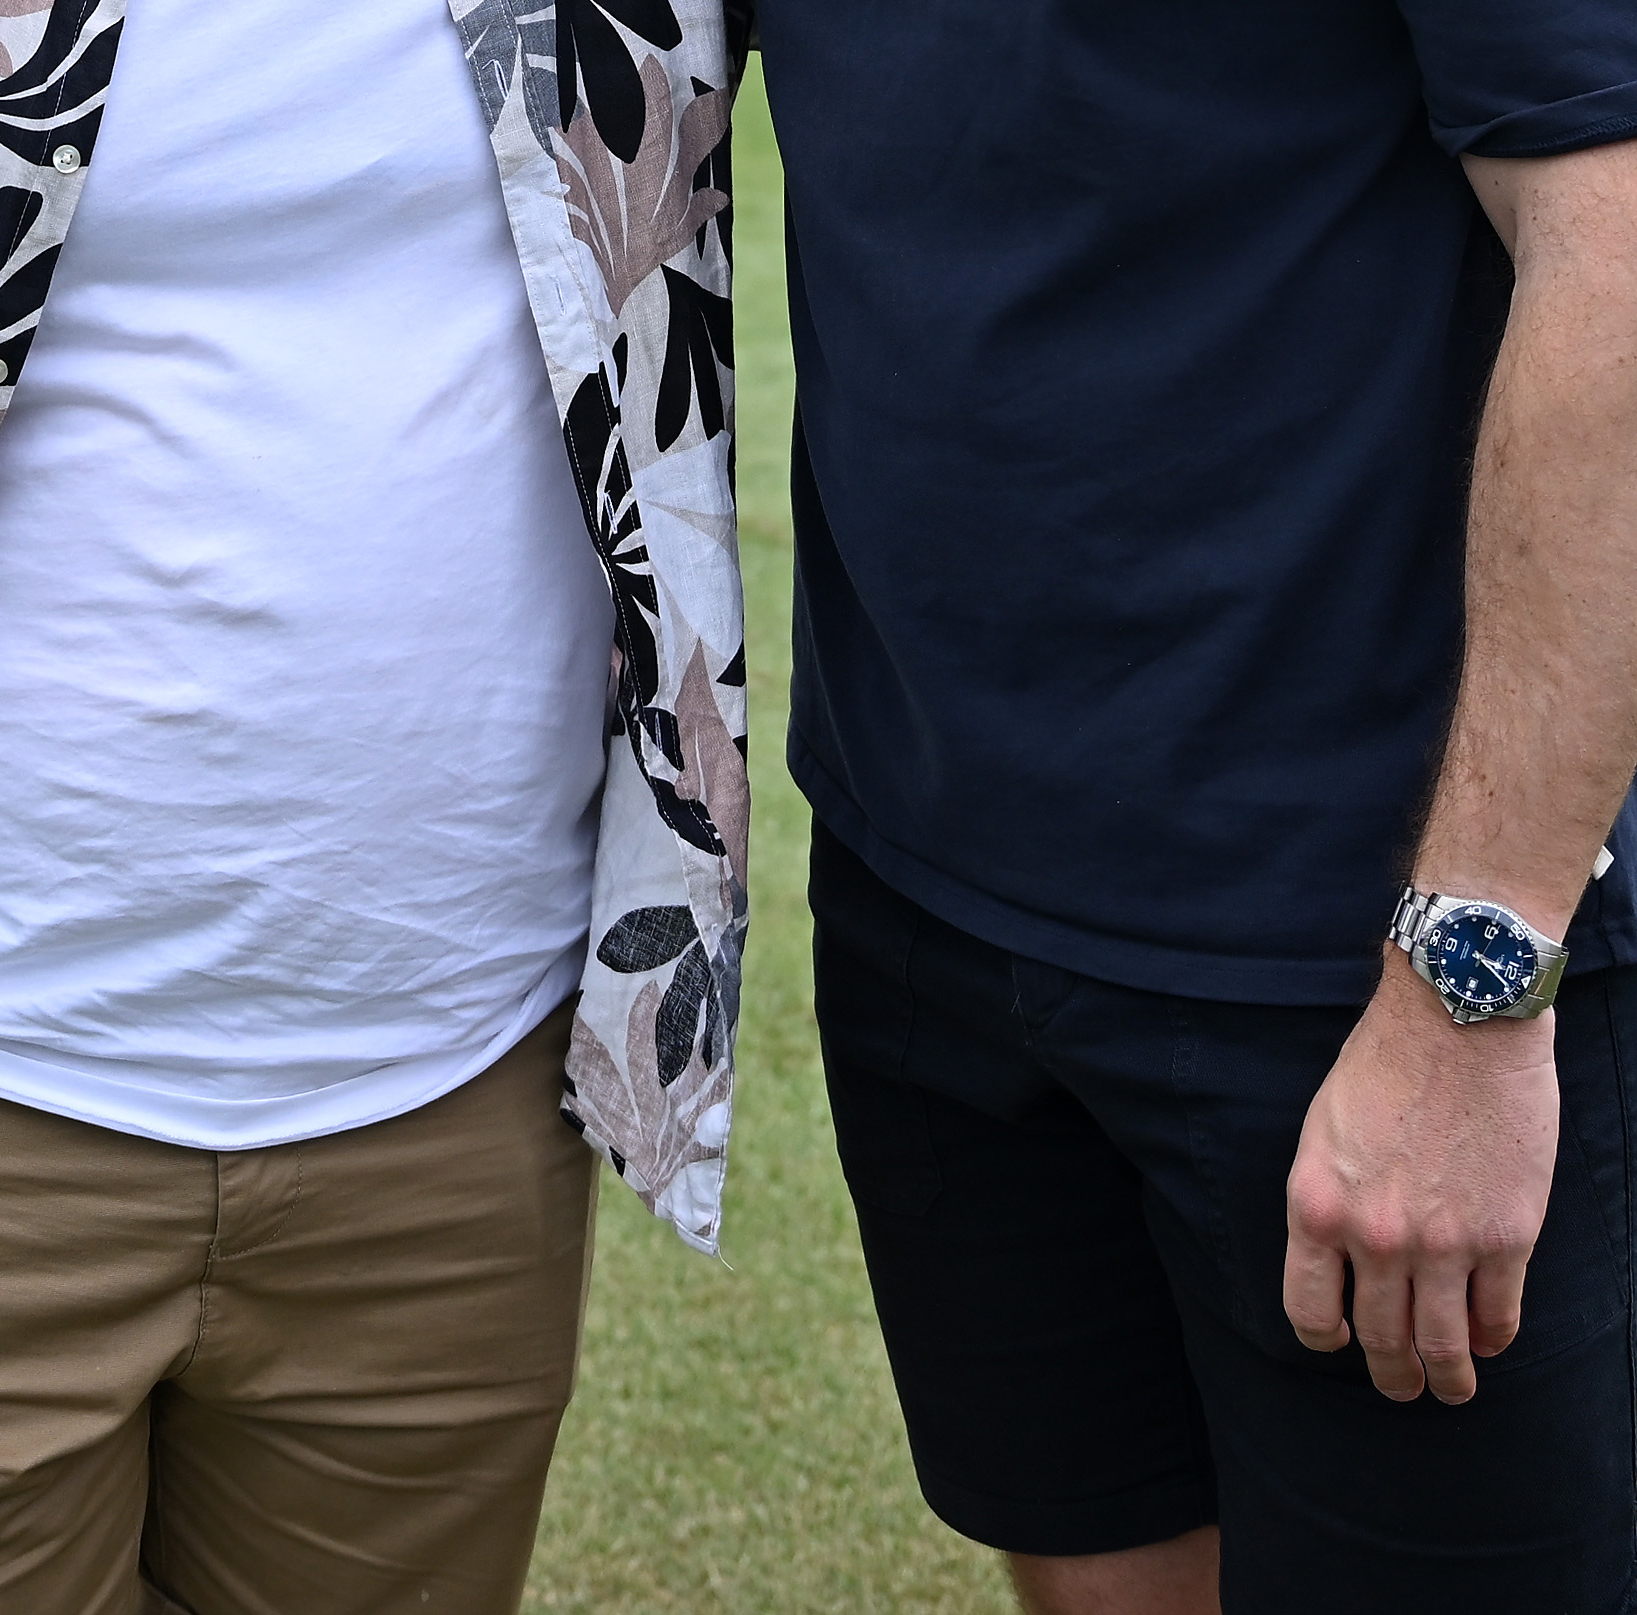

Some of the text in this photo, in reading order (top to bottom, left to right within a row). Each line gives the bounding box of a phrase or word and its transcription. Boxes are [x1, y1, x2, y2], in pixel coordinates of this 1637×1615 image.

[1465, 906, 1481, 915] 40
[1430, 930, 1441, 946] 30
[1511, 924, 1525, 940] 50
[1504, 960, 1520, 980] 12
[1436, 978, 1450, 994] 20
[1480, 1004, 1493, 1012] 10
